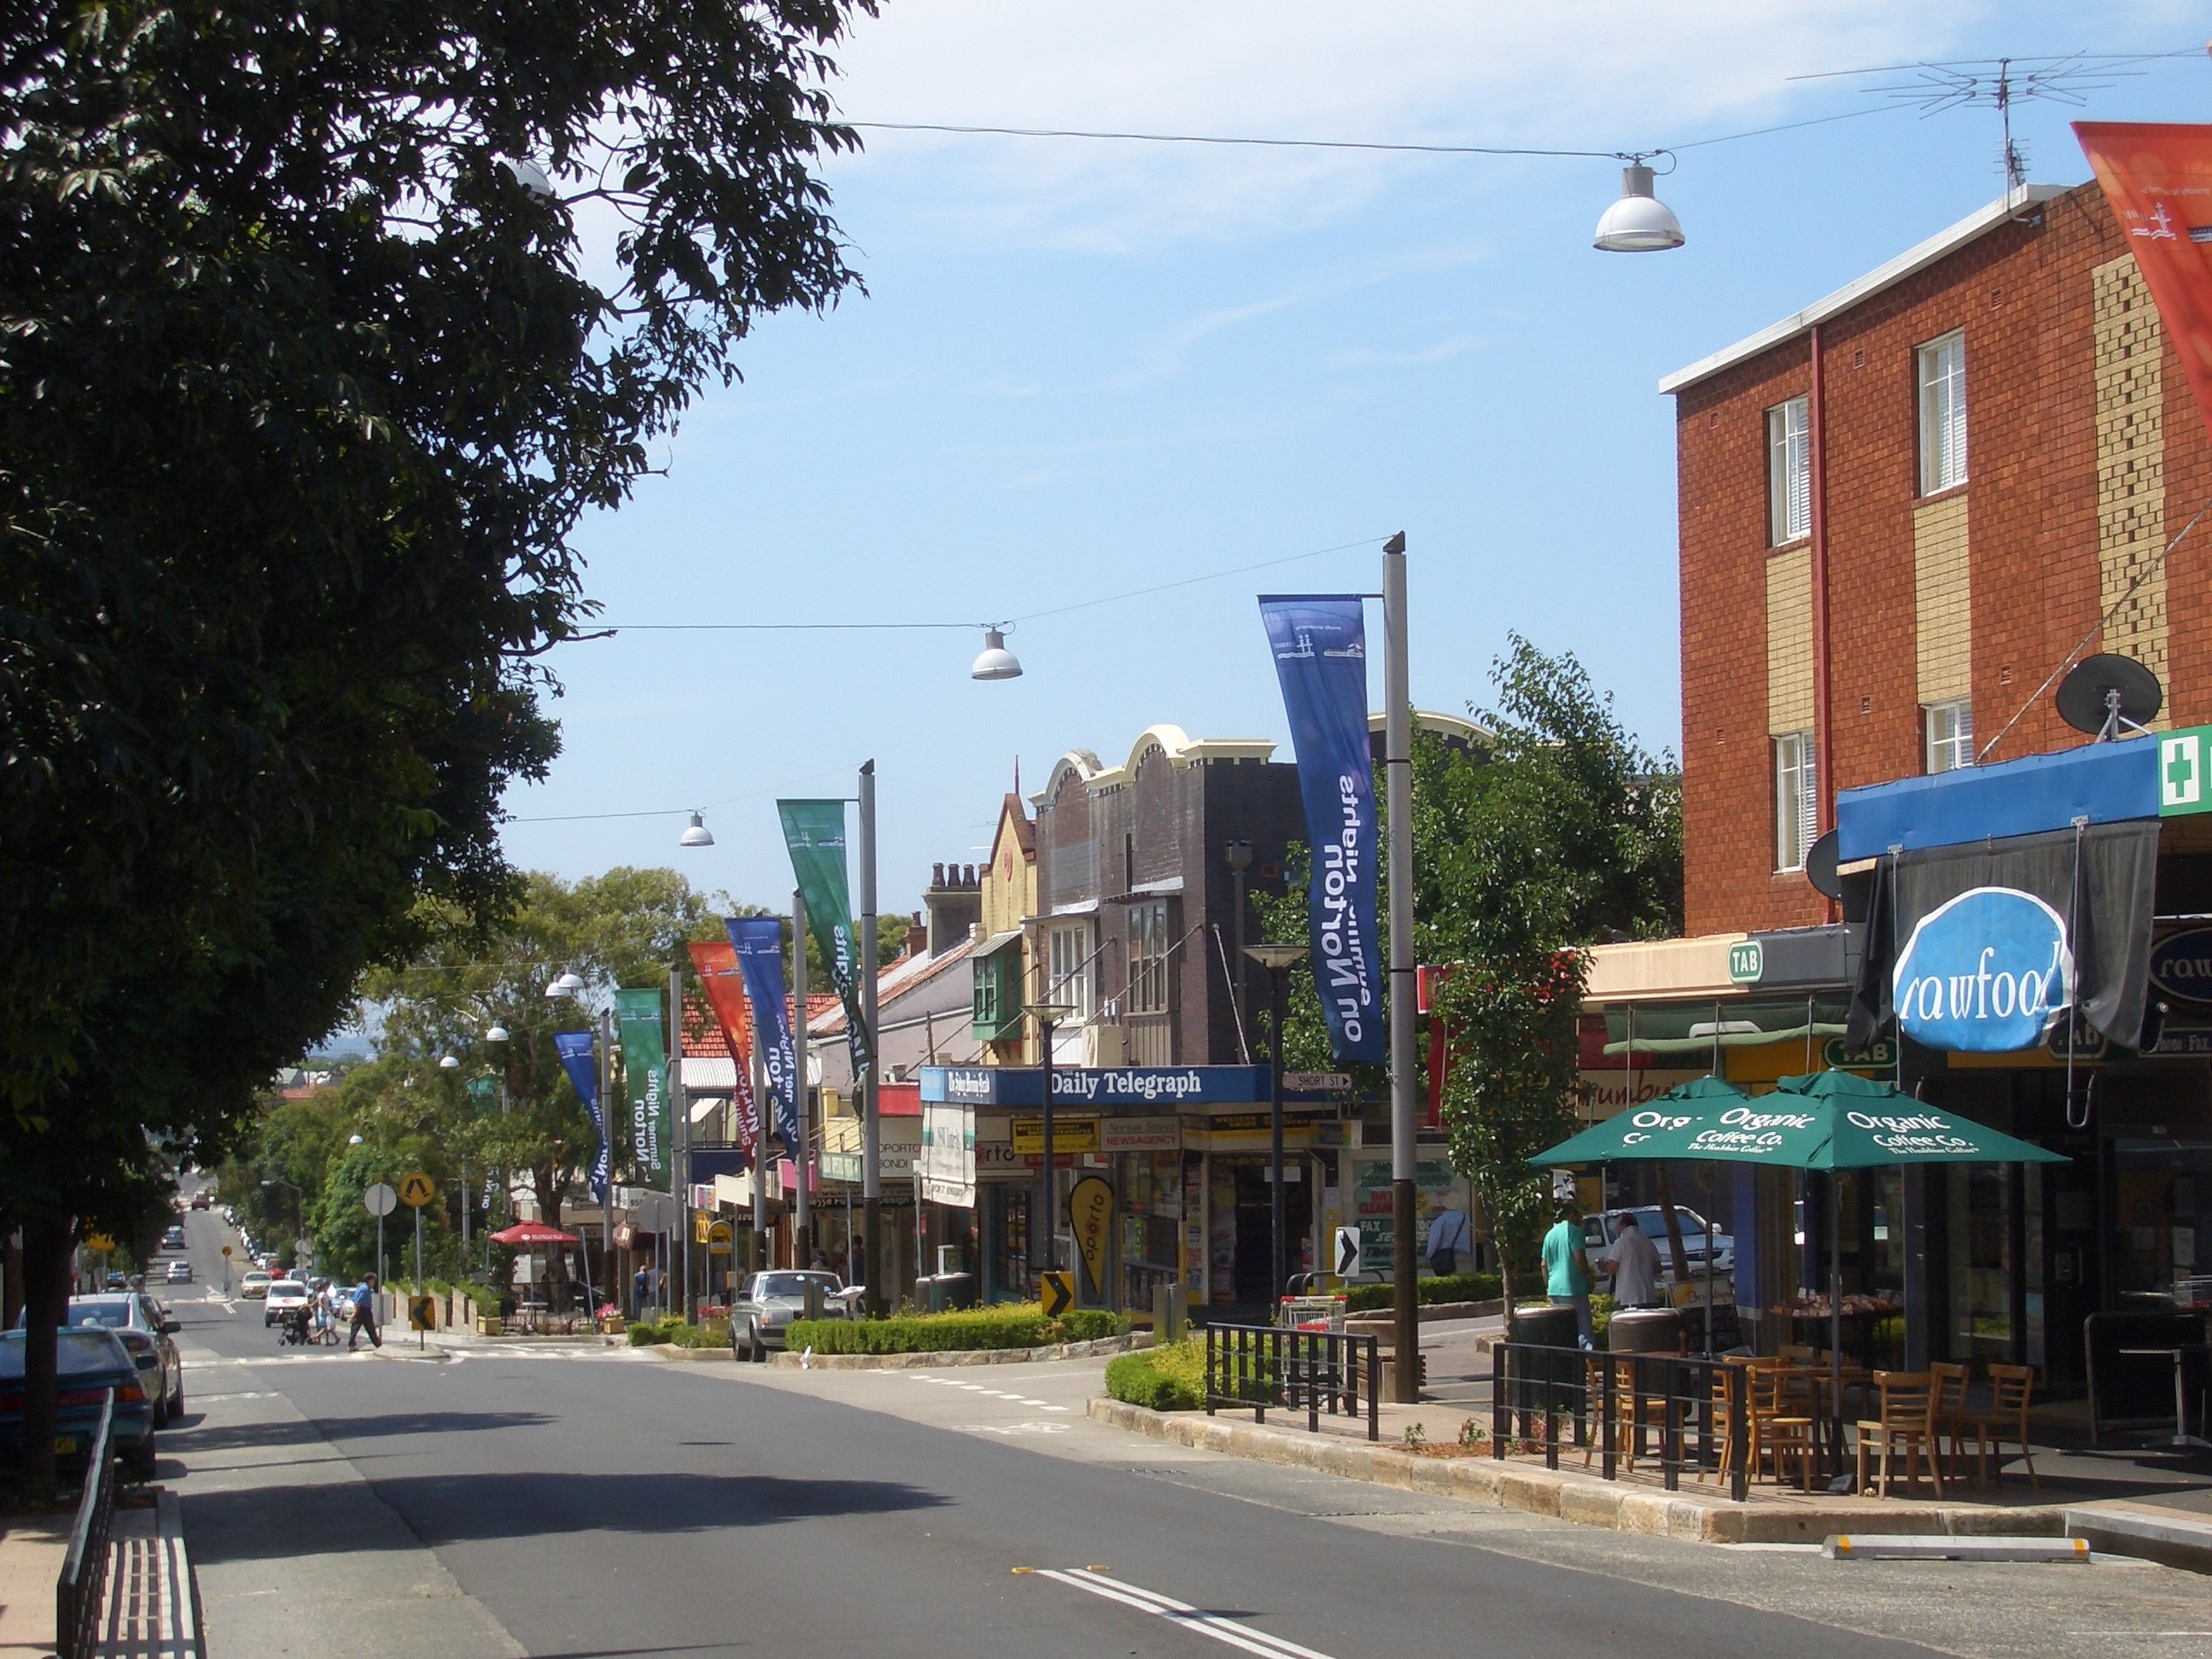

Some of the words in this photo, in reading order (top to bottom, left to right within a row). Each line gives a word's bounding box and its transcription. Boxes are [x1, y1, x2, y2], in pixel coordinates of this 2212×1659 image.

[1732, 950, 1758, 973] TAB
[1899, 941, 2062, 1021] rawfood
[1839, 1043, 1888, 1062] AB
[1051, 1071, 1099, 1100] Daily
[1102, 1070, 1202, 1099] Telegraph
[1298, 1076, 1325, 1087] SHORT
[1329, 1076, 1339, 1087] ST
[1719, 1107, 1816, 1131] Organic
[1847, 1111, 1951, 1133] Organic
[1106, 1135, 1179, 1147] NEWSAGENCY
[1696, 1129, 1755, 1144] Coffee
[1756, 1131, 1784, 1146] Co.
[1872, 1134, 1932, 1148] Coffee
[1935, 1134, 1974, 1147] Co.
[1086, 1194, 1104, 1261] oporto
[1360, 1220, 1380, 1232] FAX
